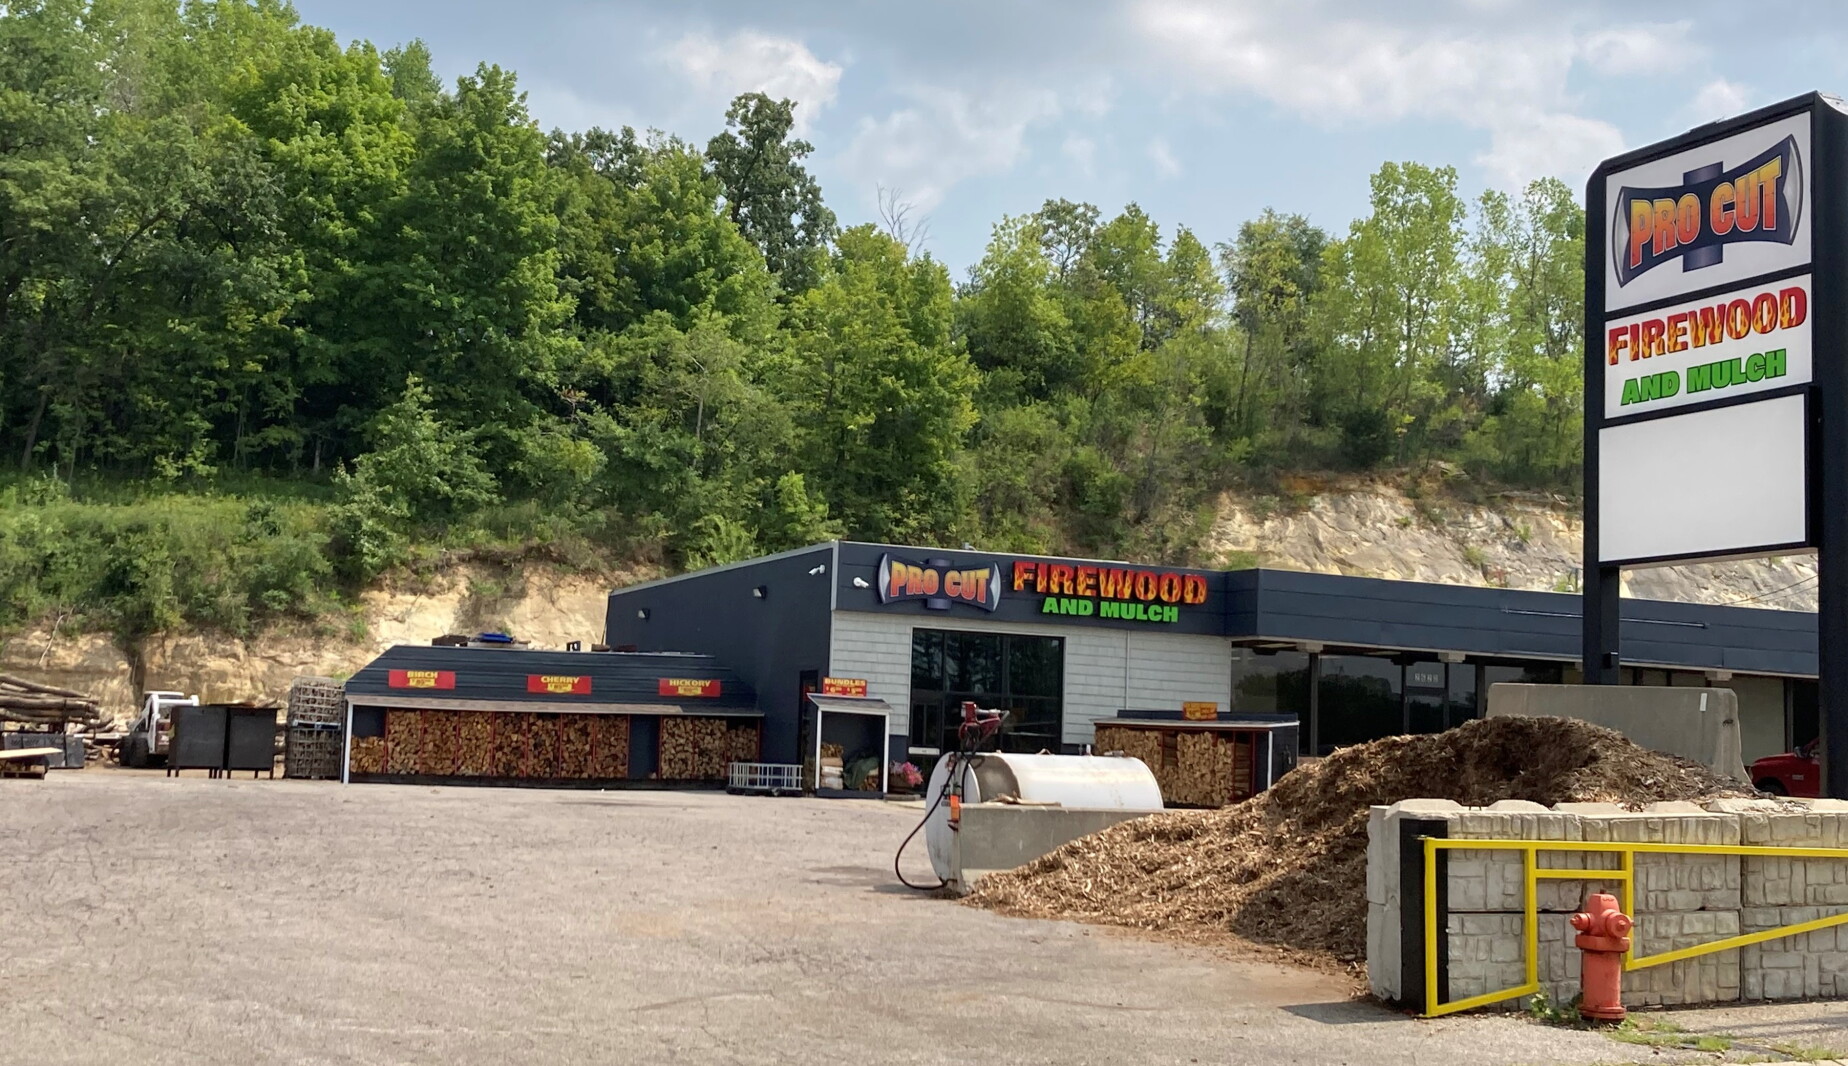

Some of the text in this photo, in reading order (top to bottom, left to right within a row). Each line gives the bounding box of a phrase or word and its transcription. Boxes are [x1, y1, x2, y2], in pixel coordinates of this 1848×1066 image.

[1629, 155, 1782, 269] PRO CUT
[1607, 286, 1808, 366] FIREWOOD
[1620, 348, 1787, 406] AND MULCH
[889, 560, 991, 604] PRO CUT
[1012, 559, 1209, 605] FIREWOOD
[1042, 596, 1179, 624] AND MULCH
[407, 670, 439, 679] BIRCH
[540, 675, 580, 684] CHERRY
[669, 679, 711, 687] HICKORY
[824, 678, 866, 686] BUNDLES
